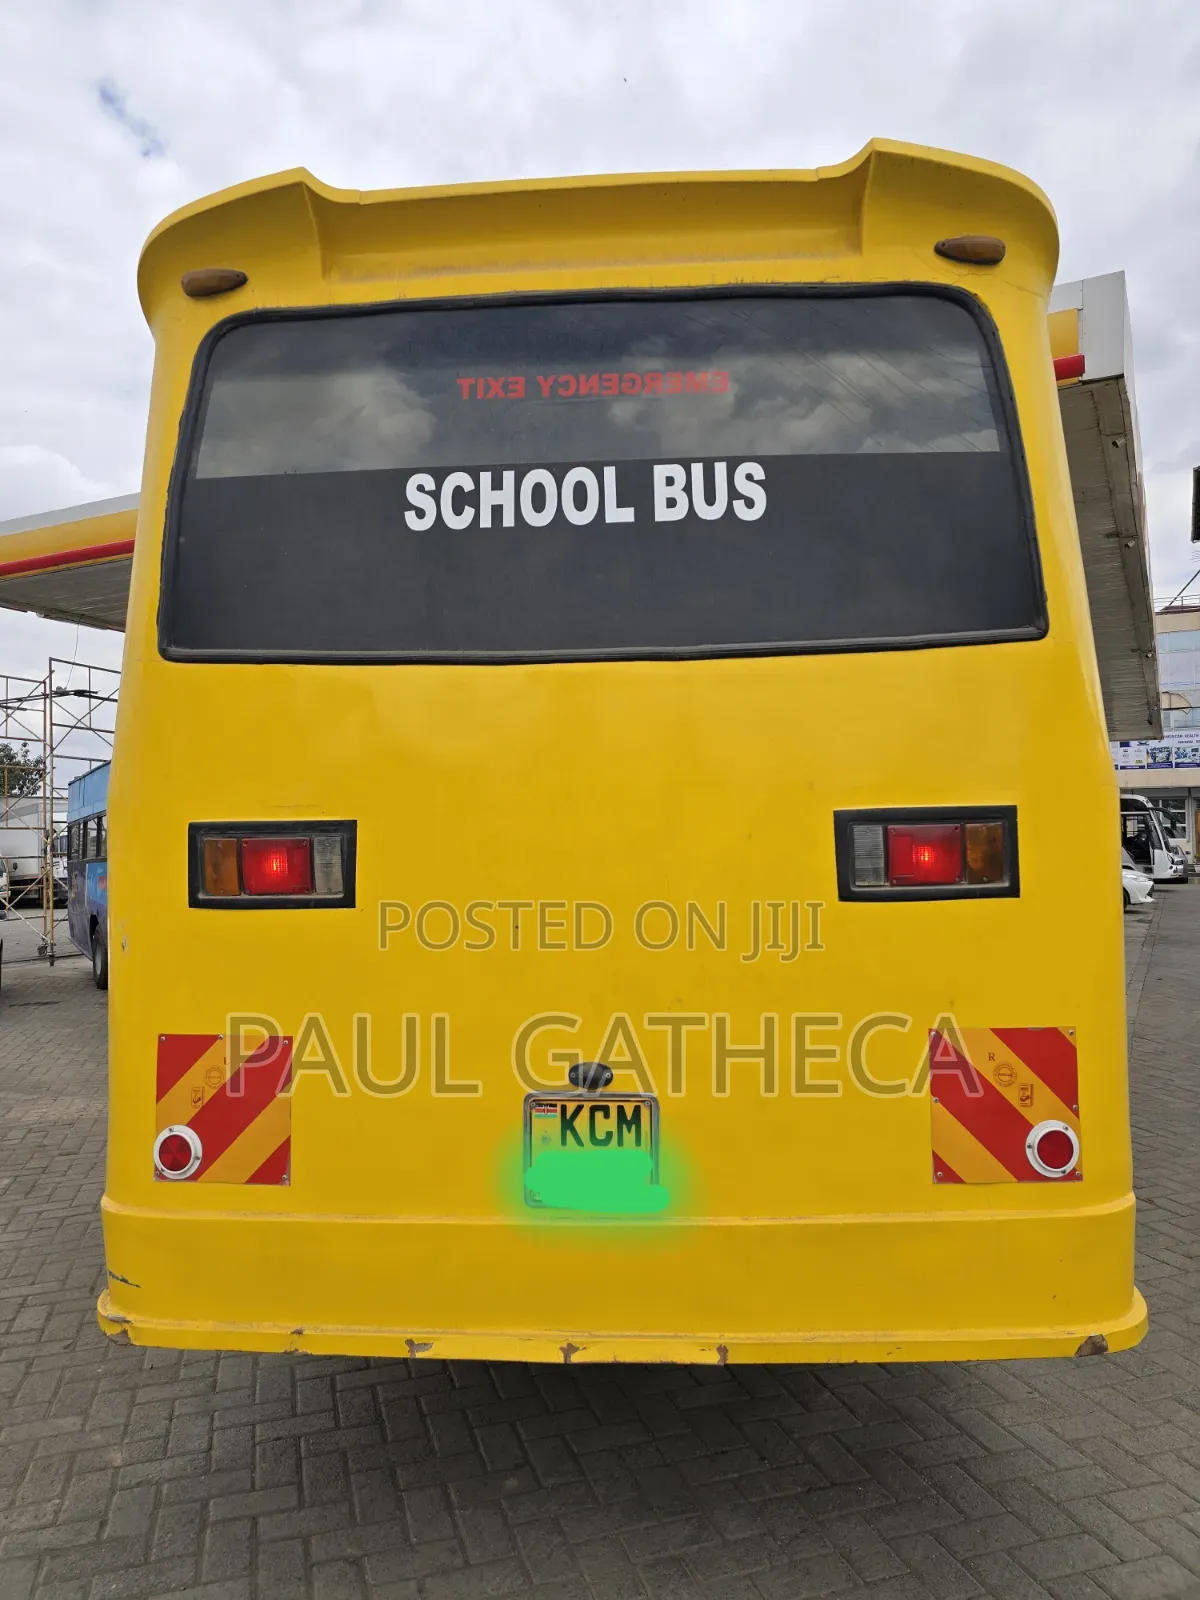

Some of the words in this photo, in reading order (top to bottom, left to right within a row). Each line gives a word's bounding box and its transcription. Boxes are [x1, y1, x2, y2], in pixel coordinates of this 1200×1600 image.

[404, 466, 635, 531] SCHOOL
[653, 461, 767, 522] BUS
[987, 1052, 996, 1062] R
[560, 1104, 642, 1147] KCM
